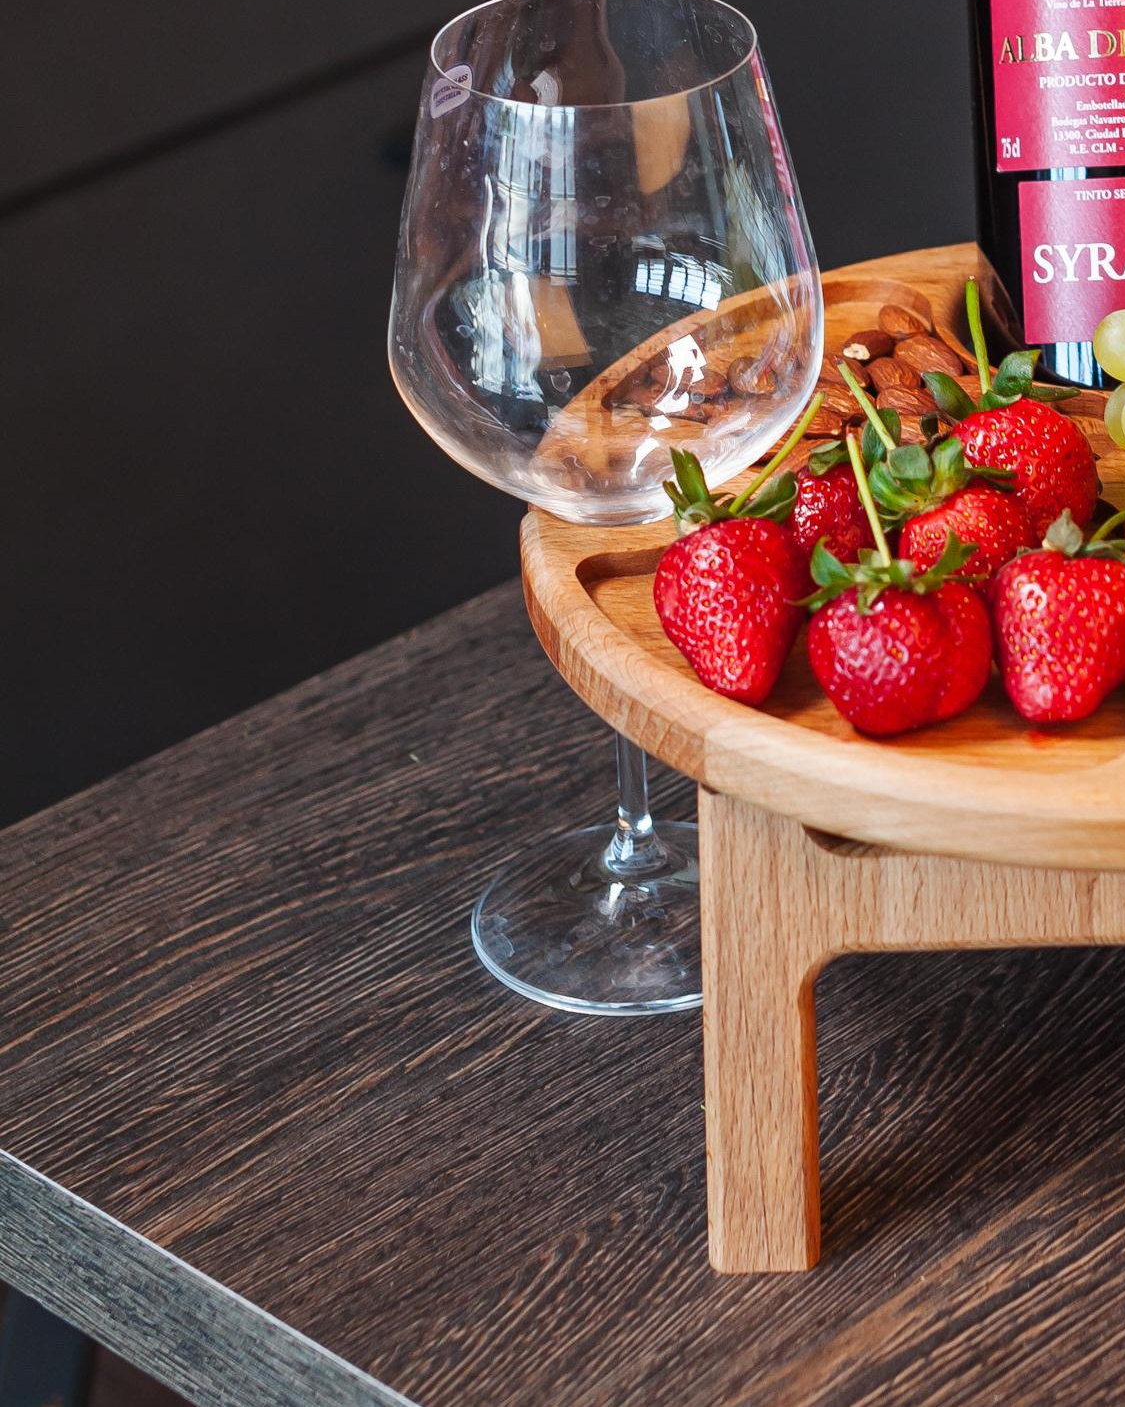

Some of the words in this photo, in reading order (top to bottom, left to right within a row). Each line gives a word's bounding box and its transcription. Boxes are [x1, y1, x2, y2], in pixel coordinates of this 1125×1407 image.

[1046, 0, 1068, 9] Vino
[1070, 0, 1081, 8] de
[999, 32, 1079, 64] ALBA
[1039, 73, 1116, 88] PRODUCTO
[1052, 117, 1087, 127] Bodegas
[1085, 128, 1119, 139] Ciudad
[1070, 144, 1089, 154] R.E.
[1091, 143, 1116, 153] CLM
[1075, 190, 1112, 201] TINTO
